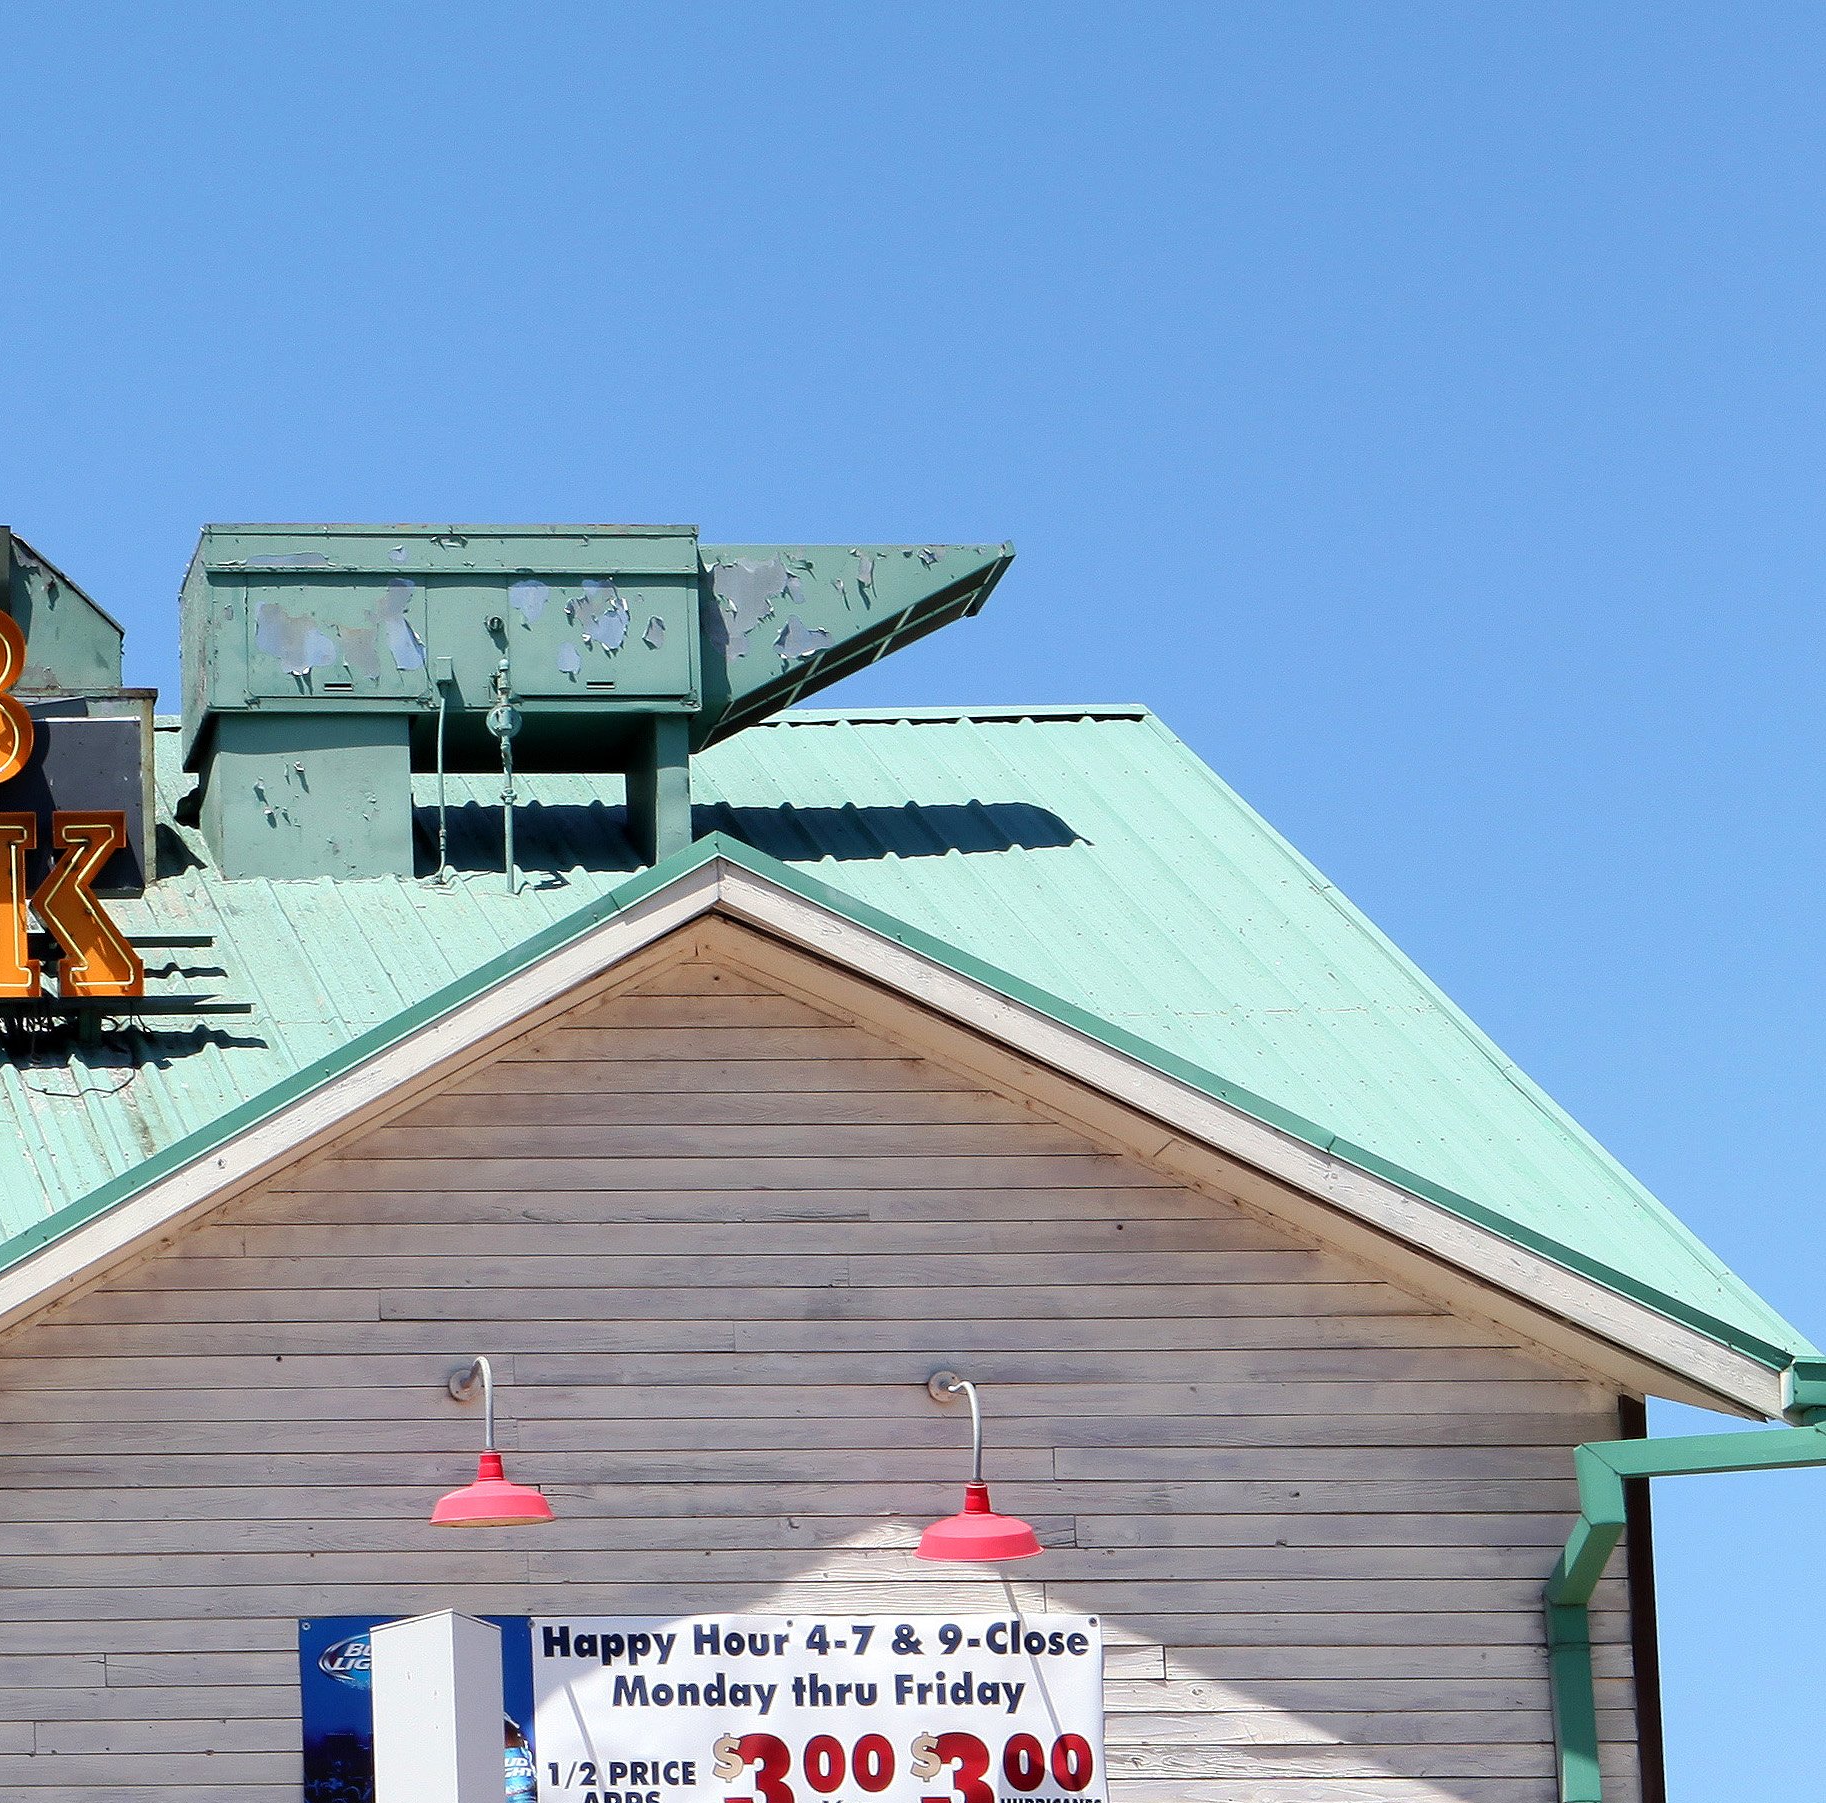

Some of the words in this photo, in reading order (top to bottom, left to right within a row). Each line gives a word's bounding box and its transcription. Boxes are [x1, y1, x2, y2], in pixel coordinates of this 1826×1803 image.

[542, 1625, 677, 1666] Happy
[693, 1623, 790, 1656] Hour
[806, 1623, 876, 1655] 4-7
[891, 1623, 925, 1655] &
[938, 1620, 1089, 1656] 9-Close
[612, 1672, 777, 1715] Monday
[792, 1672, 877, 1707] thru
[894, 1670, 1026, 1714] Friday
[548, 1760, 597, 1789] 1/2
[609, 1760, 697, 1786] PRICE
